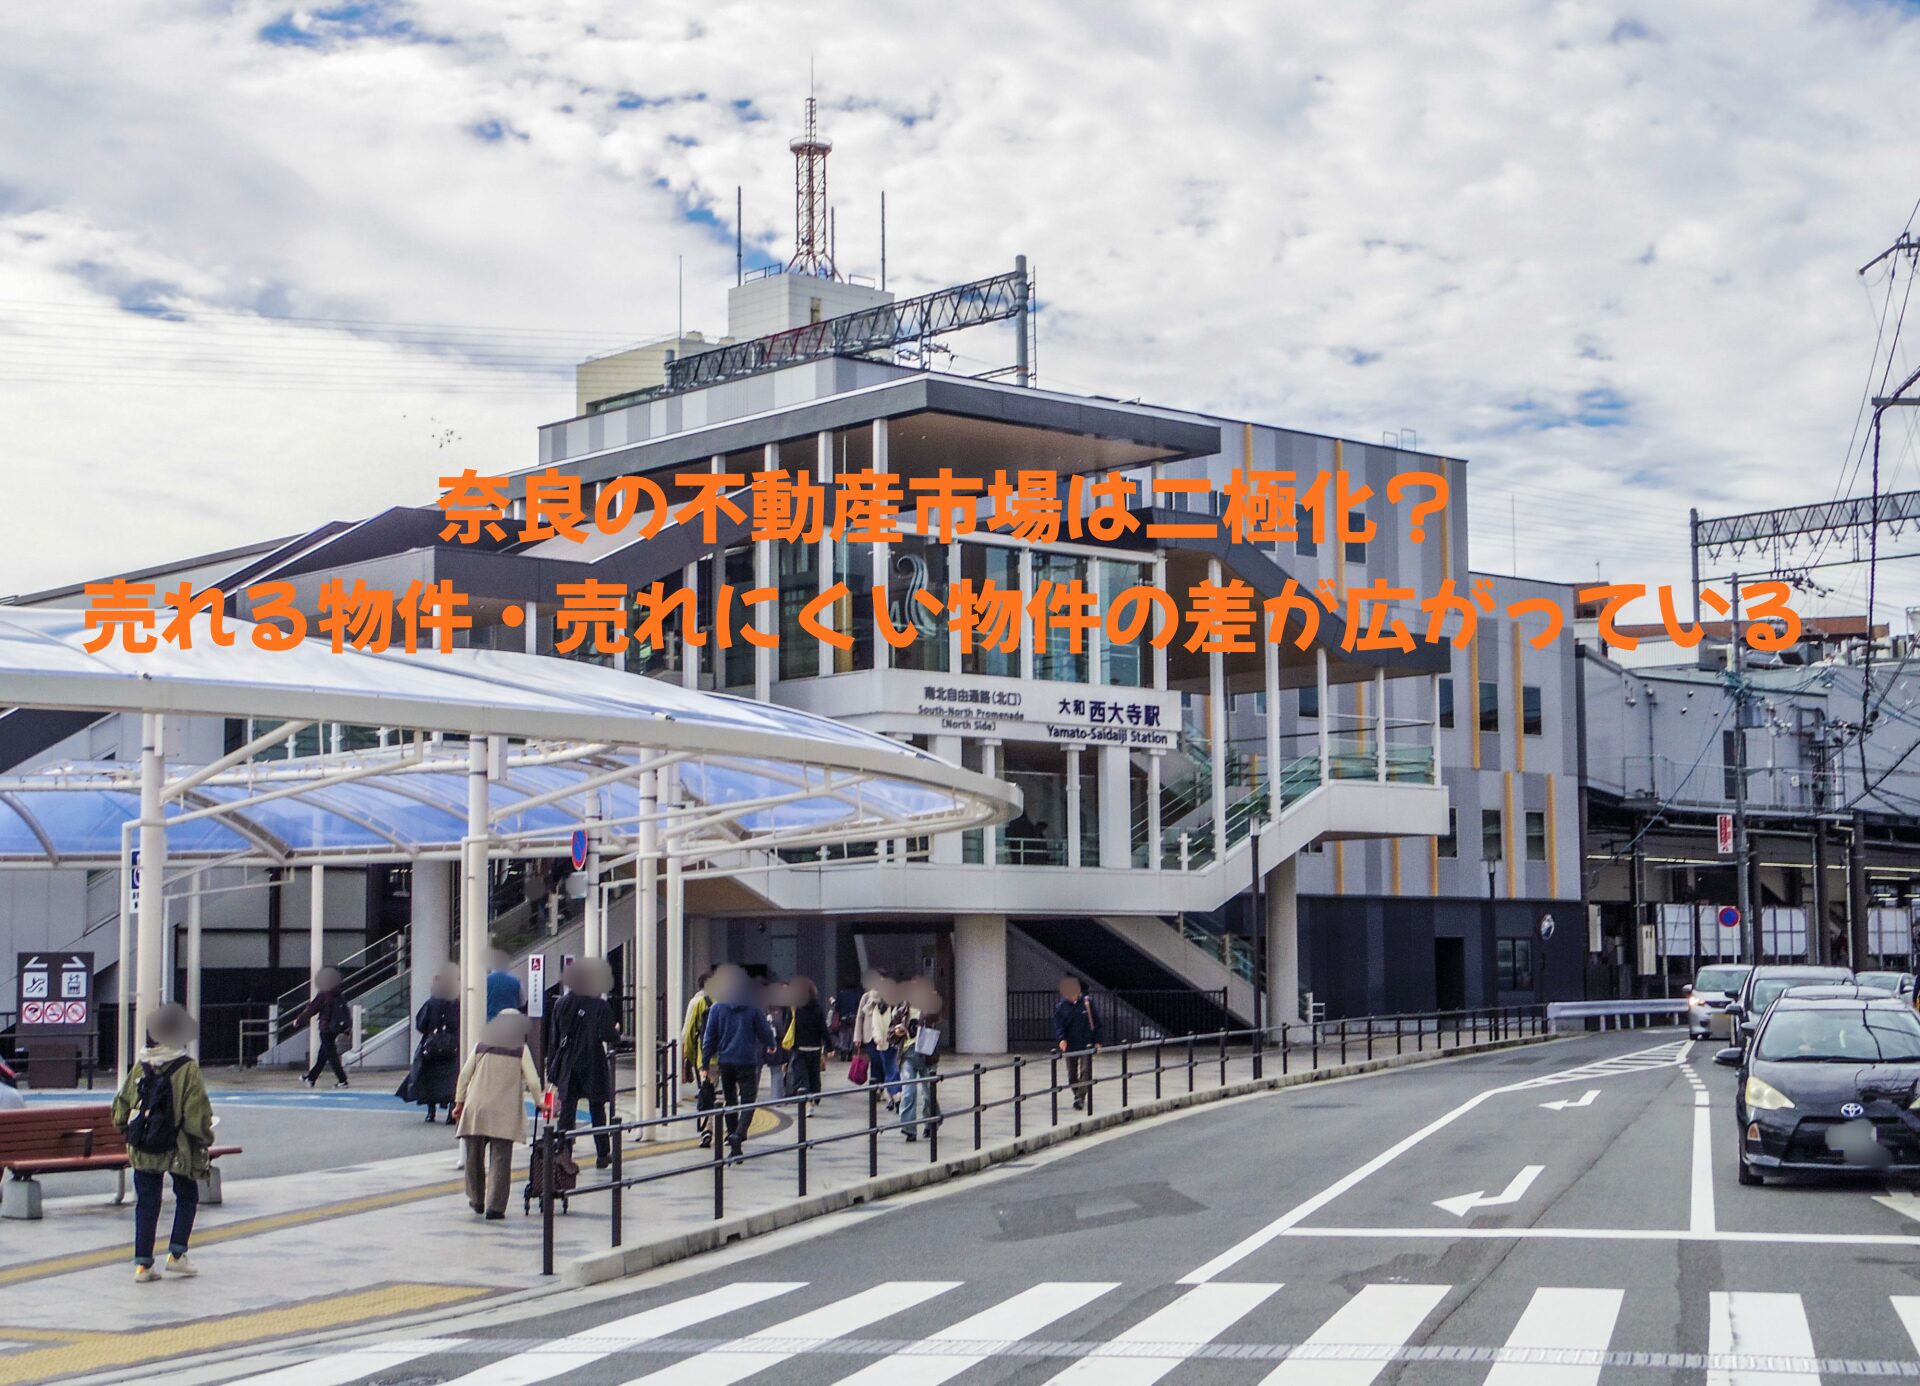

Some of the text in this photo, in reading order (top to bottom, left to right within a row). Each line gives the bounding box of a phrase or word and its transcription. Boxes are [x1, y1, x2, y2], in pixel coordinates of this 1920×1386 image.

[918, 705, 1025, 721] South-North Promenade
[1047, 724, 1168, 745] Yamato-Saidaiji Station
